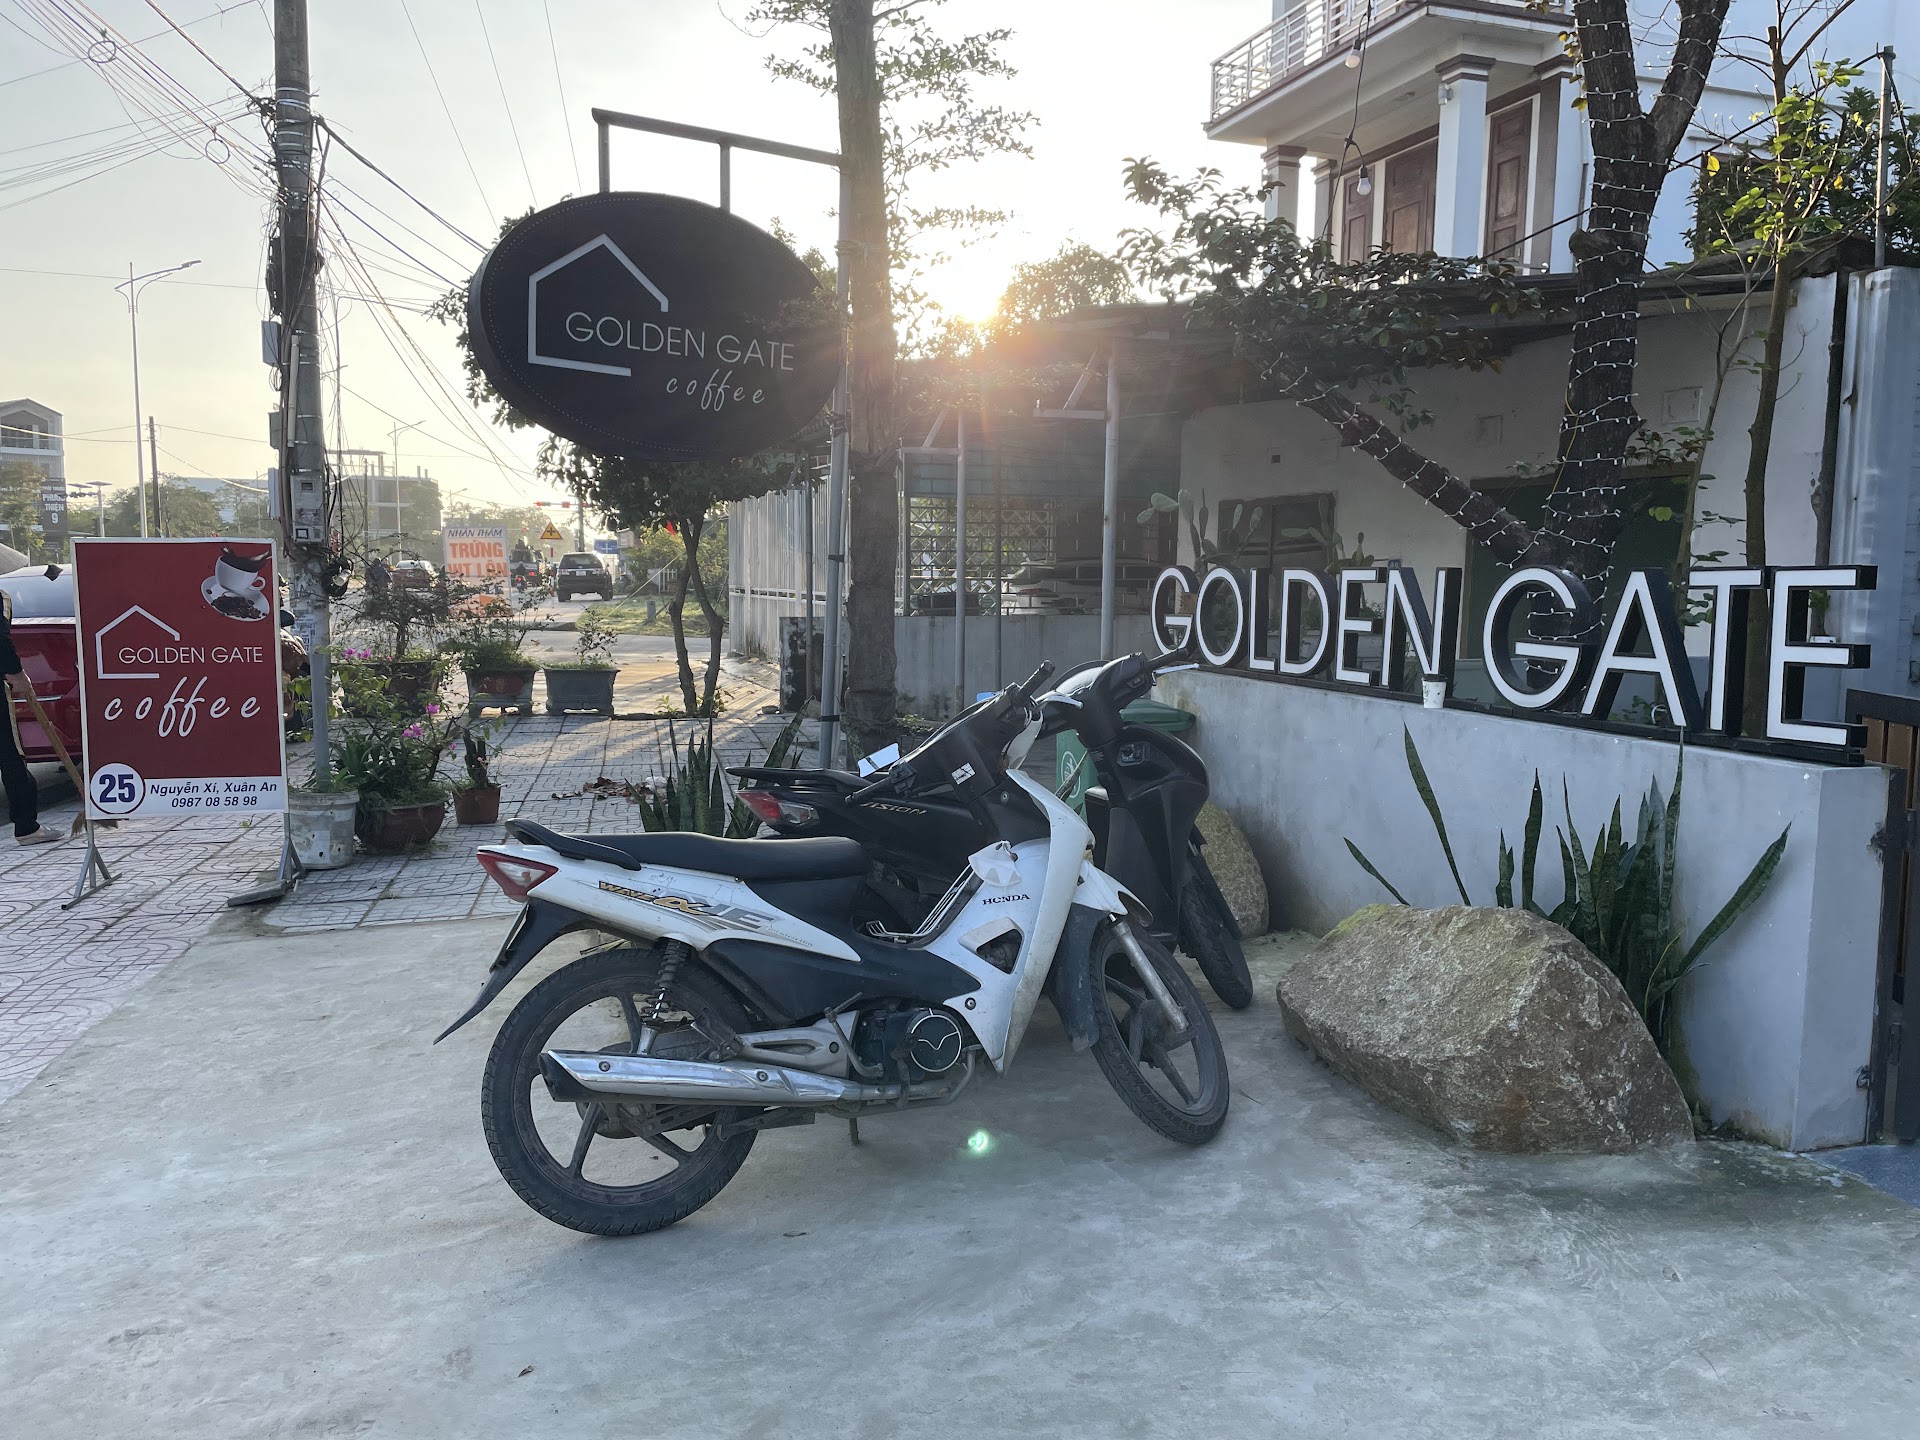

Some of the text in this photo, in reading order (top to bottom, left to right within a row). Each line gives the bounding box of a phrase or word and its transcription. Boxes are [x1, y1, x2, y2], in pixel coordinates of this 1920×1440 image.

[565, 311, 795, 371] GOLDEN GATE
[666, 369, 765, 411] coffee
[449, 539, 503, 558] TRỨNG
[118, 646, 263, 664] GOLDEN GATE
[1151, 565, 1862, 749] GOLDEN GATE
[104, 676, 261, 737] coffee
[98, 773, 136, 804] 25
[150, 781, 199, 797] Nguyễn
[223, 782, 256, 793] Xuân
[259, 781, 277, 792] An
[171, 795, 258, 808] 0987 08 58 98
[982, 893, 1031, 906] HONDA
